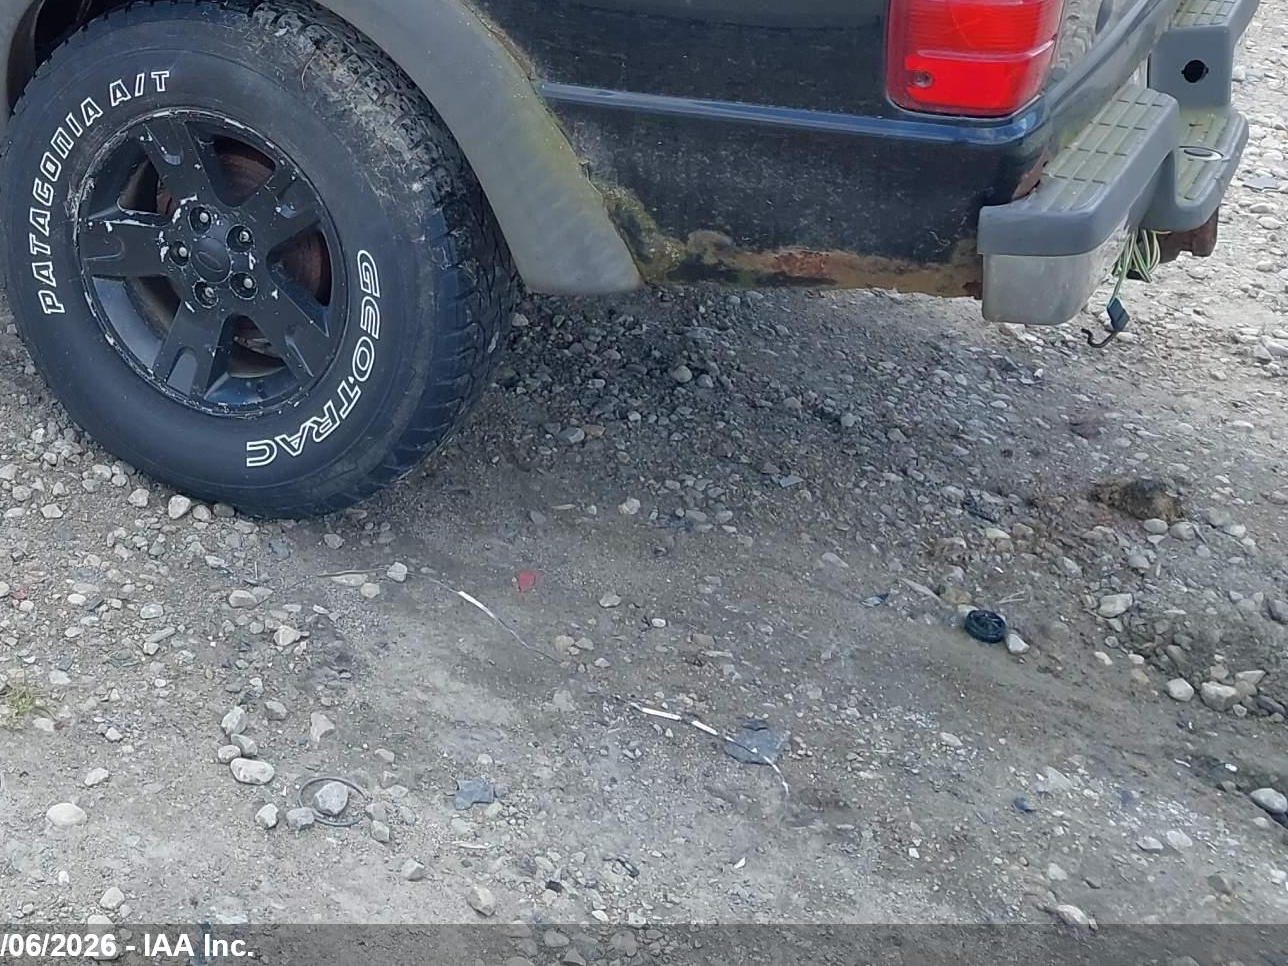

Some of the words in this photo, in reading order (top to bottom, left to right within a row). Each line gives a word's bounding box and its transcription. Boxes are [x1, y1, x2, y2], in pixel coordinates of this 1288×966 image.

[28, 96, 104, 315] PATAGONIA
[109, 70, 170, 107] A/T
[246, 249, 381, 467] GEOTRAC
